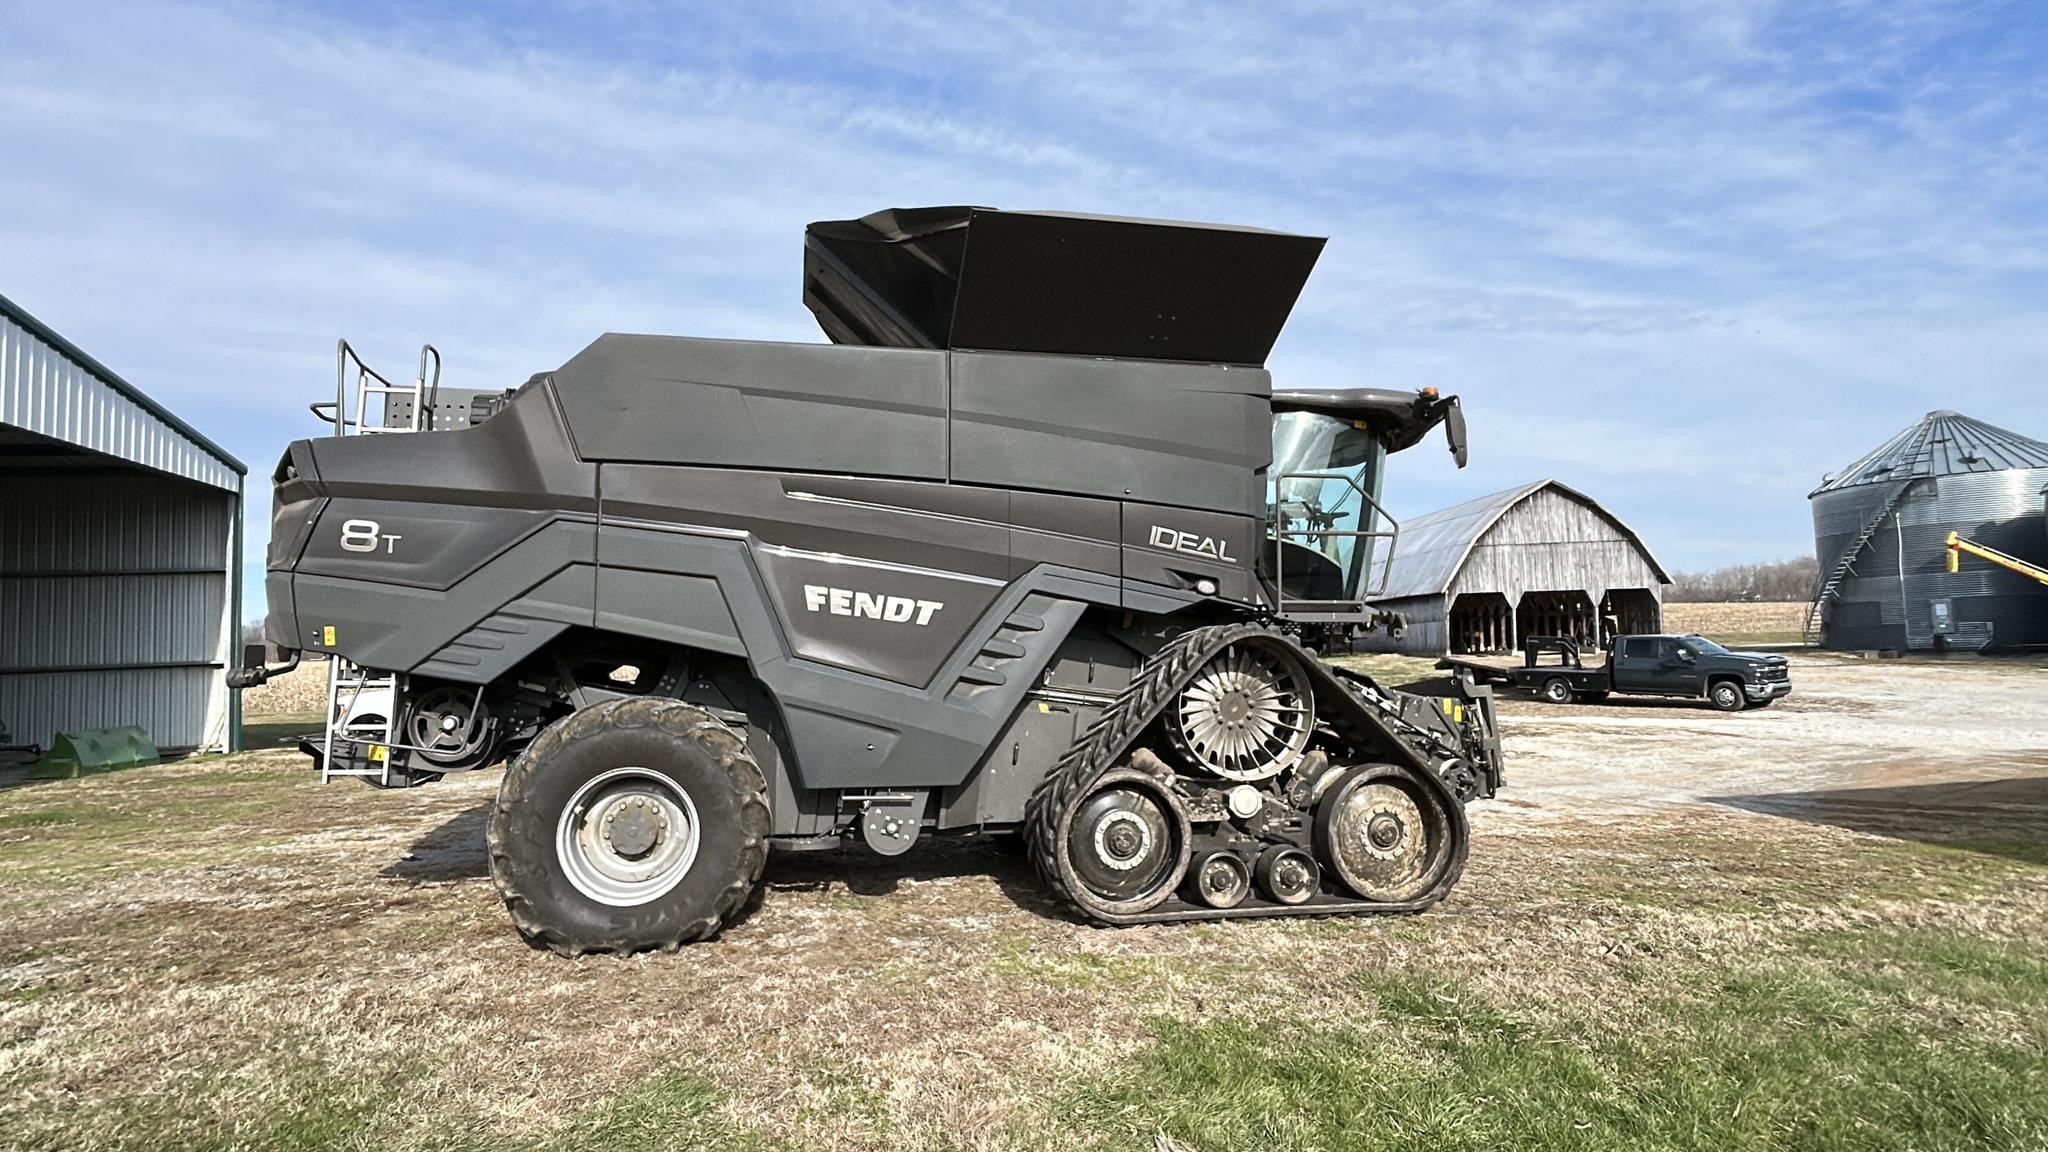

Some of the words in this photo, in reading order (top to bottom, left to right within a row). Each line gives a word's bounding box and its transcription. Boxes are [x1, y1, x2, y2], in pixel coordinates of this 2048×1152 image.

[340, 519, 402, 554] 8T
[1149, 525, 1237, 563] IDEAL
[803, 584, 944, 626] FENDT
